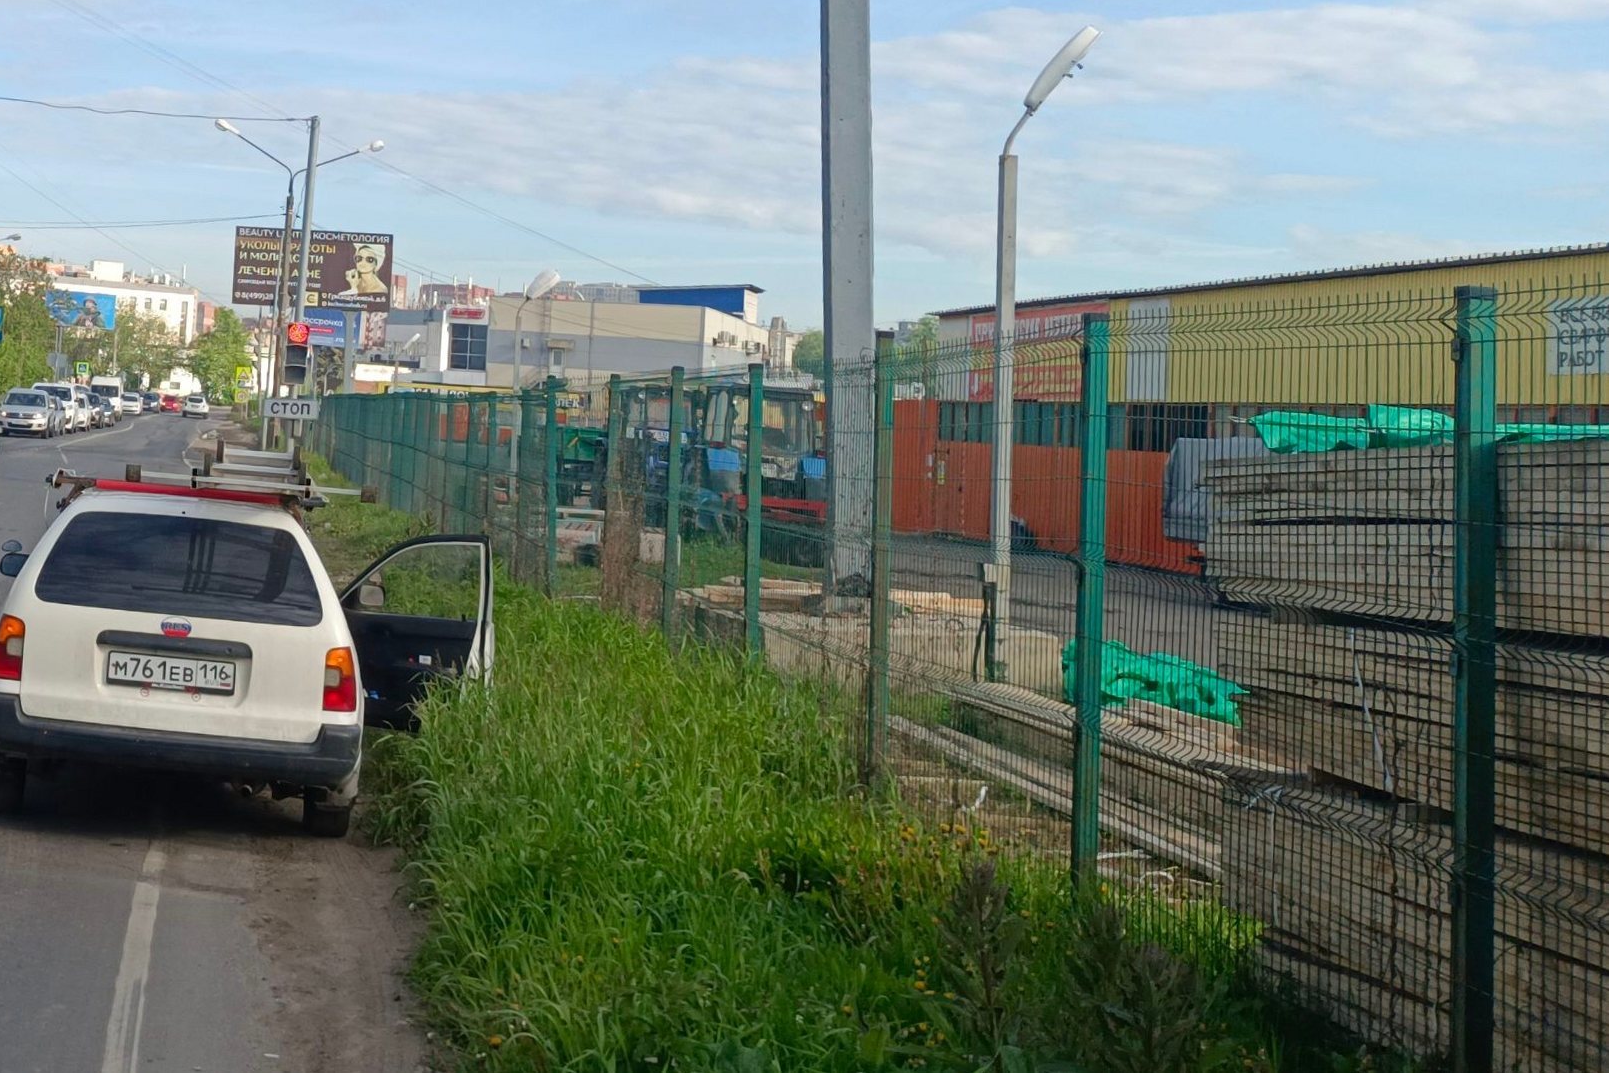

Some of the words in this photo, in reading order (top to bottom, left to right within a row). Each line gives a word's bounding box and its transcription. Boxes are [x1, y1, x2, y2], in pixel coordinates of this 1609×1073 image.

[239, 228, 274, 238] BEAUTY
[313, 231, 390, 244] КОСМЕТОЛОГИЯ
[291, 268, 321, 279] АНЕ
[1560, 327, 1609, 345] СВАРО
[1558, 349, 1604, 367] РАБОТ
[270, 402, 311, 415] СТОП
[114, 657, 194, 683] М761ЕВ
[200, 663, 228, 681] 116
